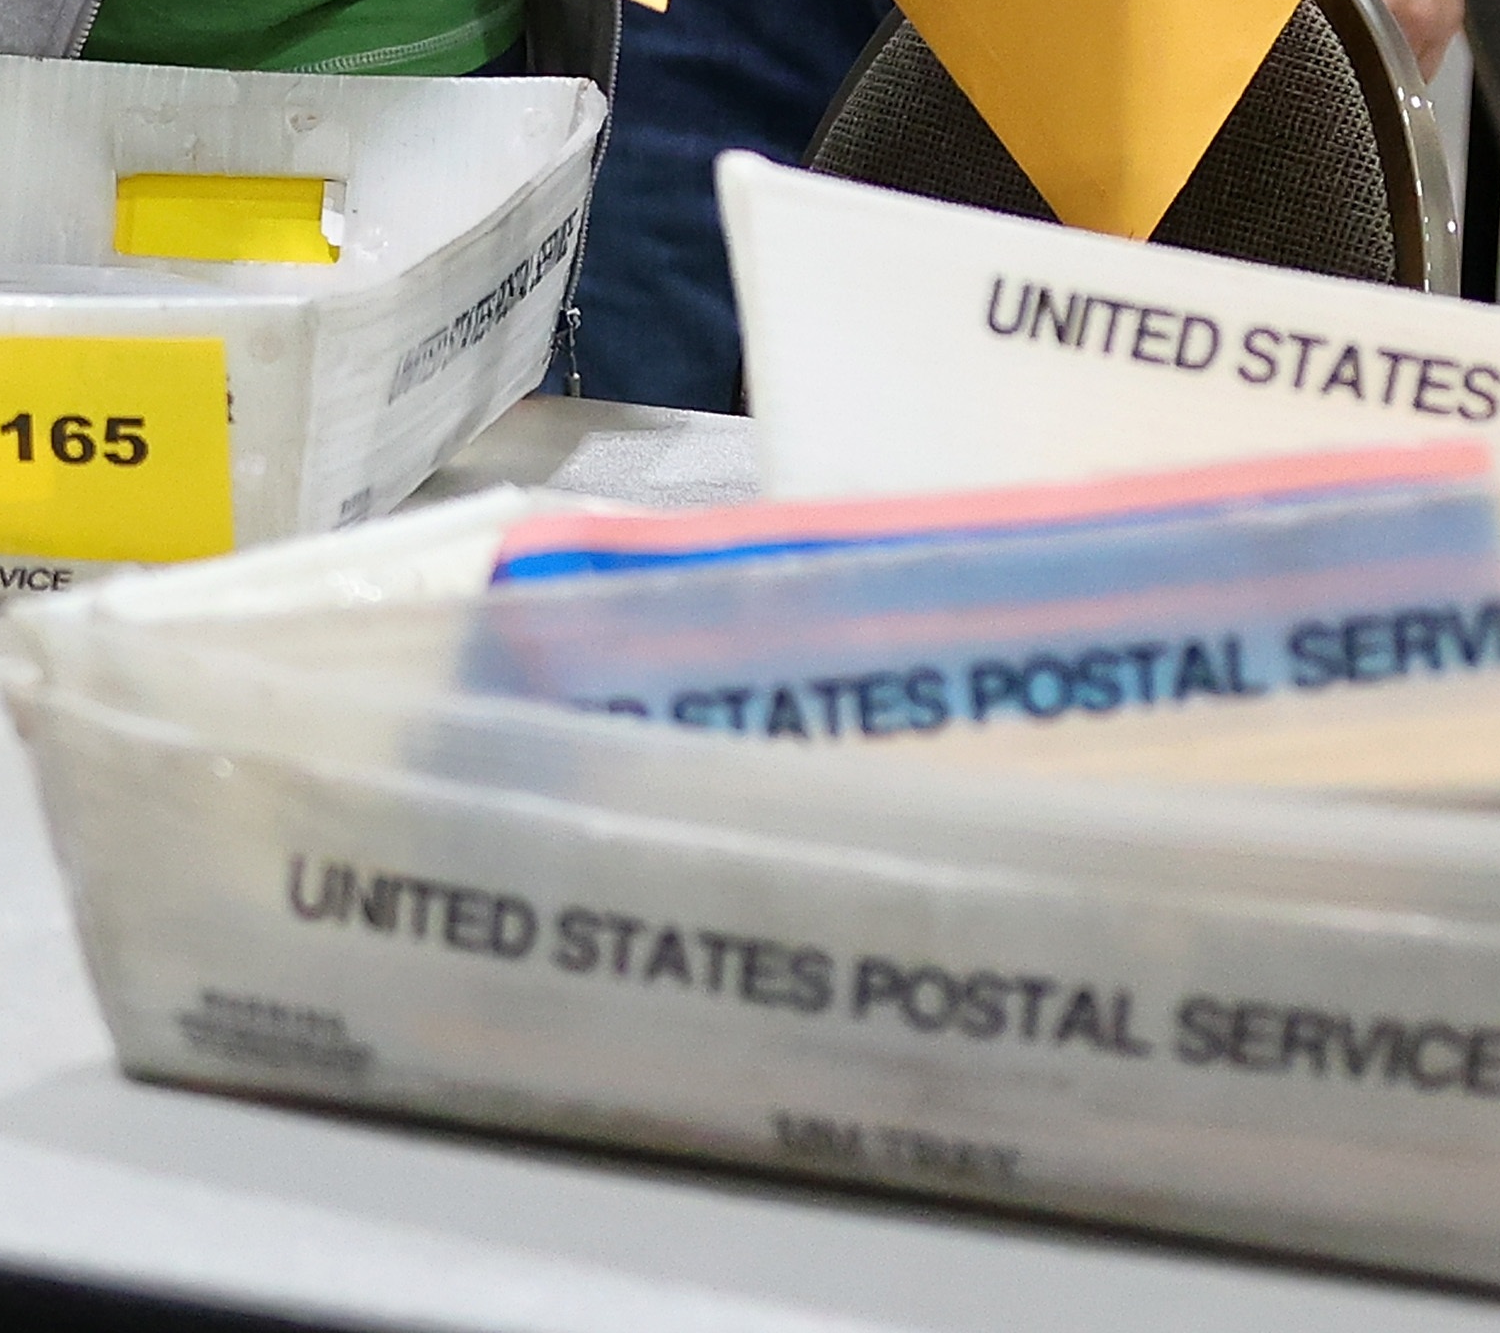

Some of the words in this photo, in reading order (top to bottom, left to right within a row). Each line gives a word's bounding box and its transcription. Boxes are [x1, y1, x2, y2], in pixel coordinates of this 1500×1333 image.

[984, 275, 1221, 372] UNITED
[0, 413, 149, 467] 165
[669, 664, 951, 740] STATES
[968, 642, 1250, 726] POSTAL
[286, 853, 538, 961] UNITED
[551, 904, 832, 1019] STATES
[851, 957, 1151, 1061] POSTAL
